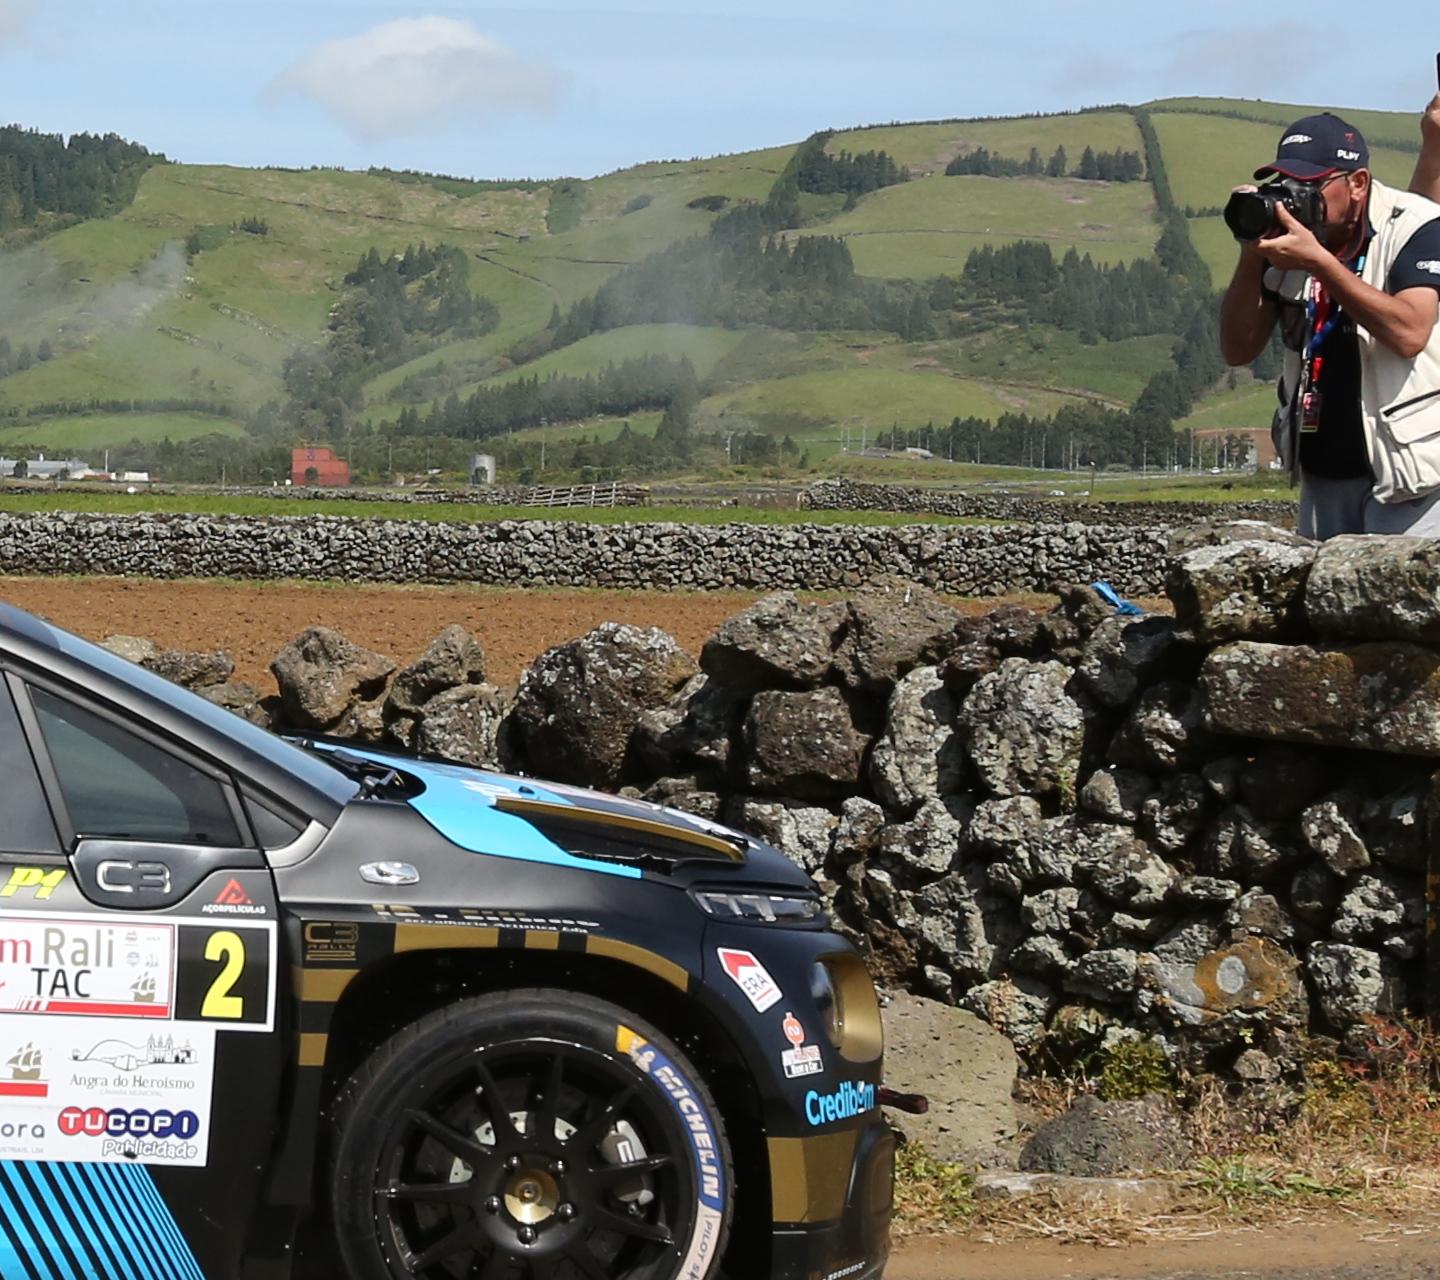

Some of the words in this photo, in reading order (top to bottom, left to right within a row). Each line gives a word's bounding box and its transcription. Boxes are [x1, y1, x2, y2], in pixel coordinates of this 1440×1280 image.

[96, 860, 171, 894] C3
[43, 927, 114, 968] Rali
[305, 922, 359, 944] C3
[30, 967, 92, 998] TAC
[200, 930, 247, 1018] 2
[742, 972, 770, 996] ERA
[70, 1073, 108, 1089] Angra
[113, 1074, 129, 1088] do
[805, 1081, 874, 1126] Credibom
[61, 1110, 193, 1135] TUCOPI
[654, 1066, 719, 1198] MICHELIN
[699, 1221, 713, 1262] PILOT
